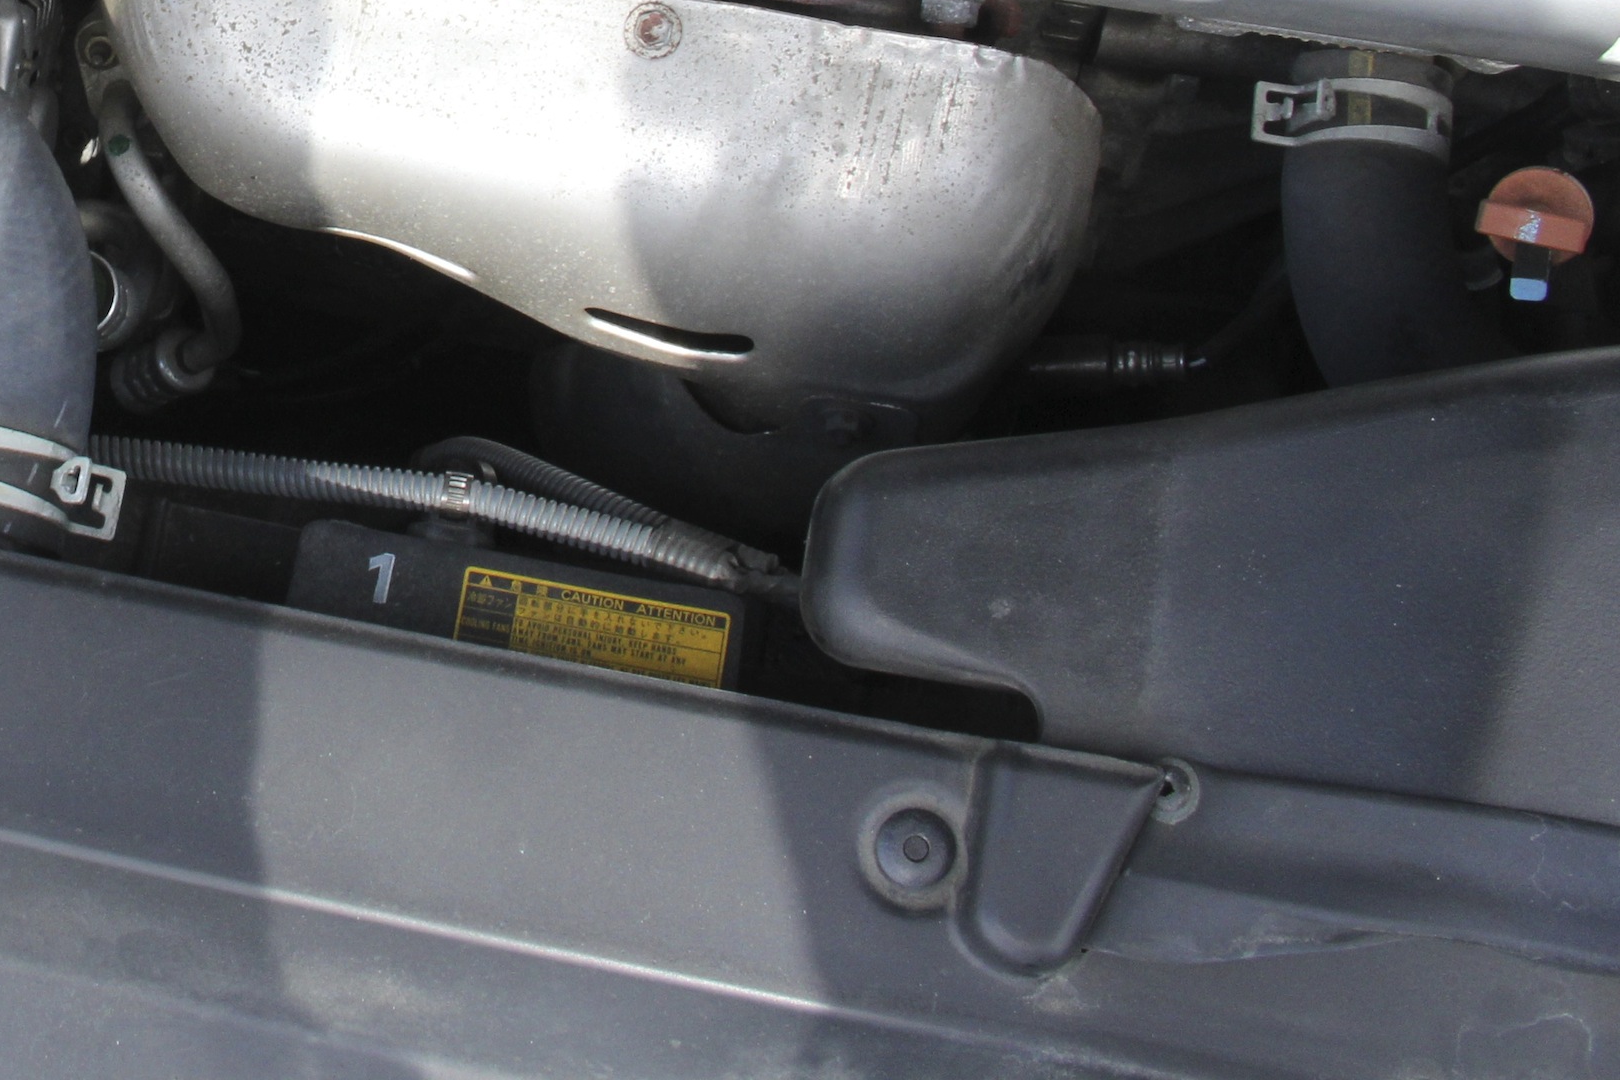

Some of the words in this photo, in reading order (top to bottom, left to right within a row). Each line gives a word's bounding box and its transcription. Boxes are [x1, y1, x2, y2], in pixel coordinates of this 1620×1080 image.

[368, 552, 396, 604] 1
[560, 588, 624, 610] CAUTION
[637, 602, 716, 627] ATTENTION
[651, 643, 677, 655] HANDS
